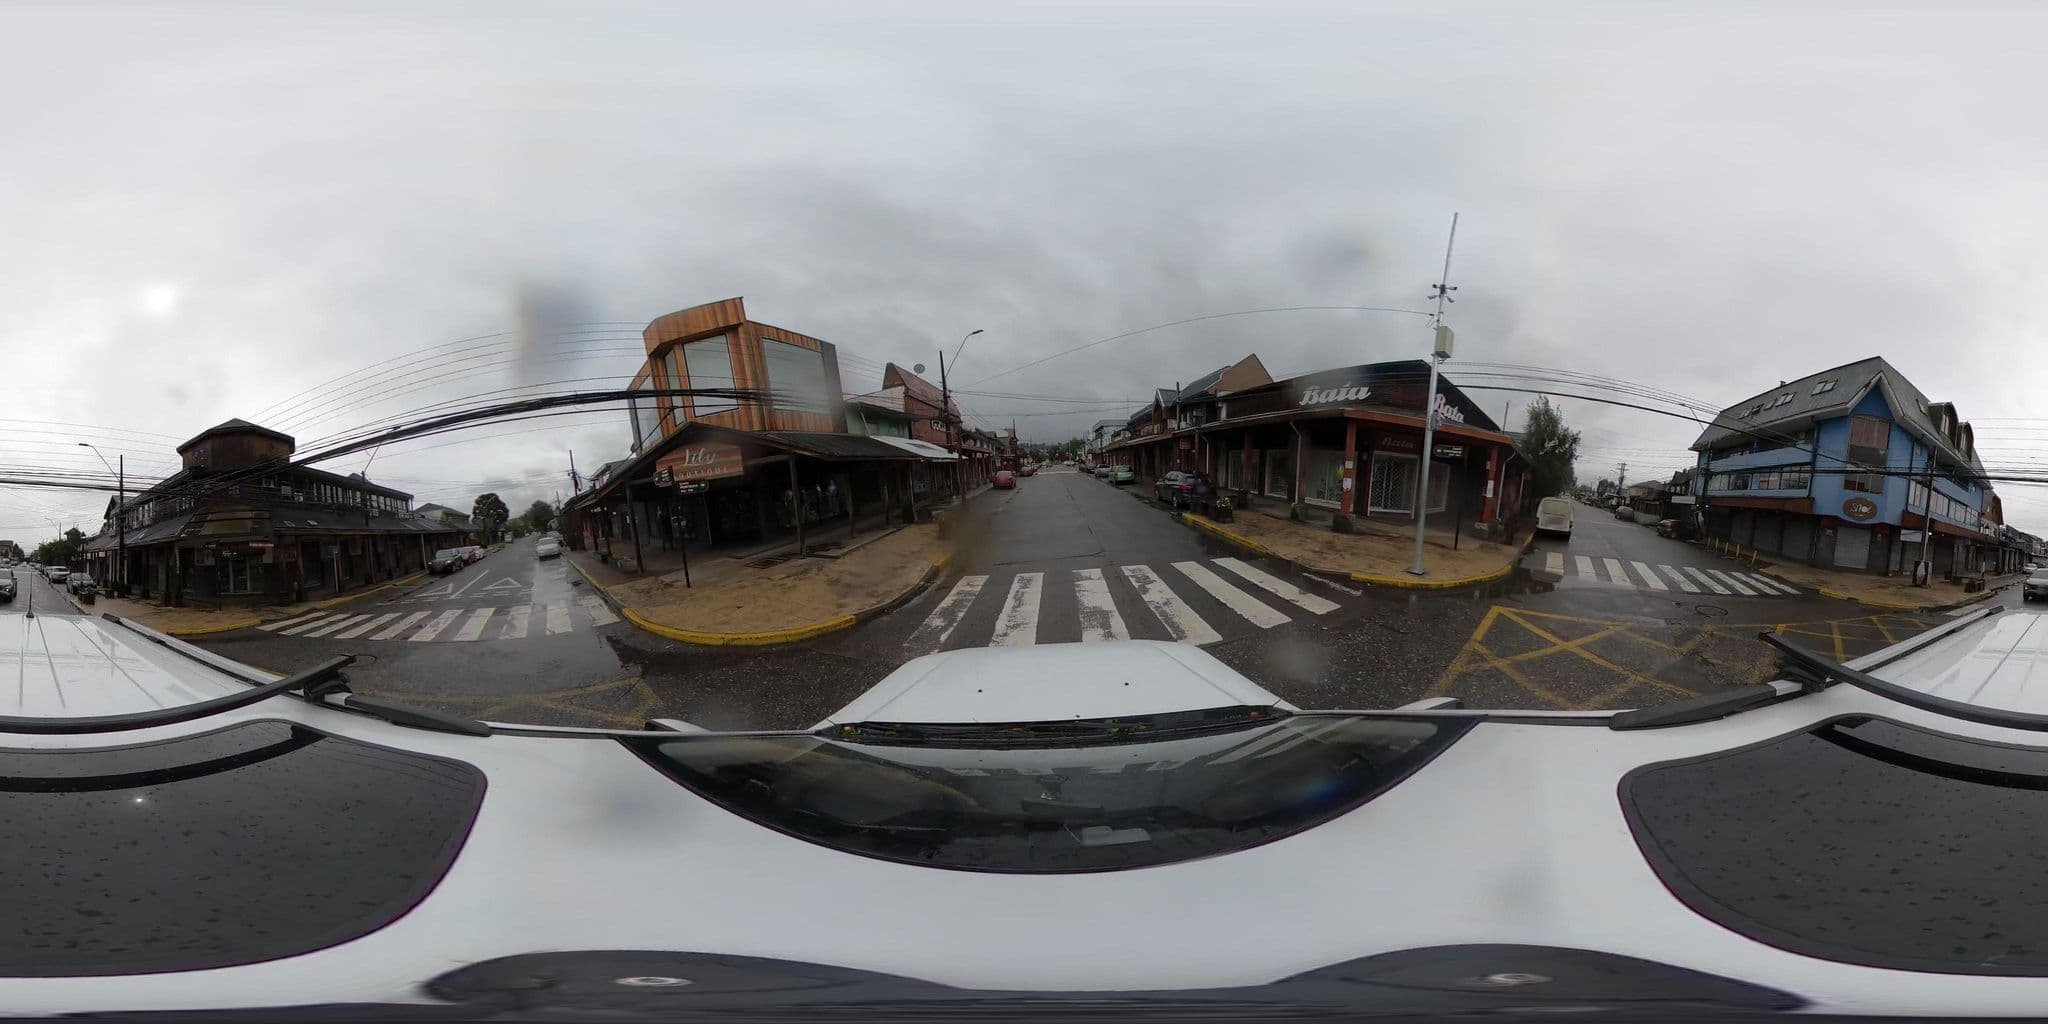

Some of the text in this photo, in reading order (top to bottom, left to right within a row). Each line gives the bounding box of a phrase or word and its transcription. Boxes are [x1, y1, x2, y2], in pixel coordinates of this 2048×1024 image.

[1299, 382, 1371, 406] Bata
[1434, 393, 1465, 423] Bata
[684, 447, 717, 466] Lily
[678, 467, 729, 479] OUTIQUE
